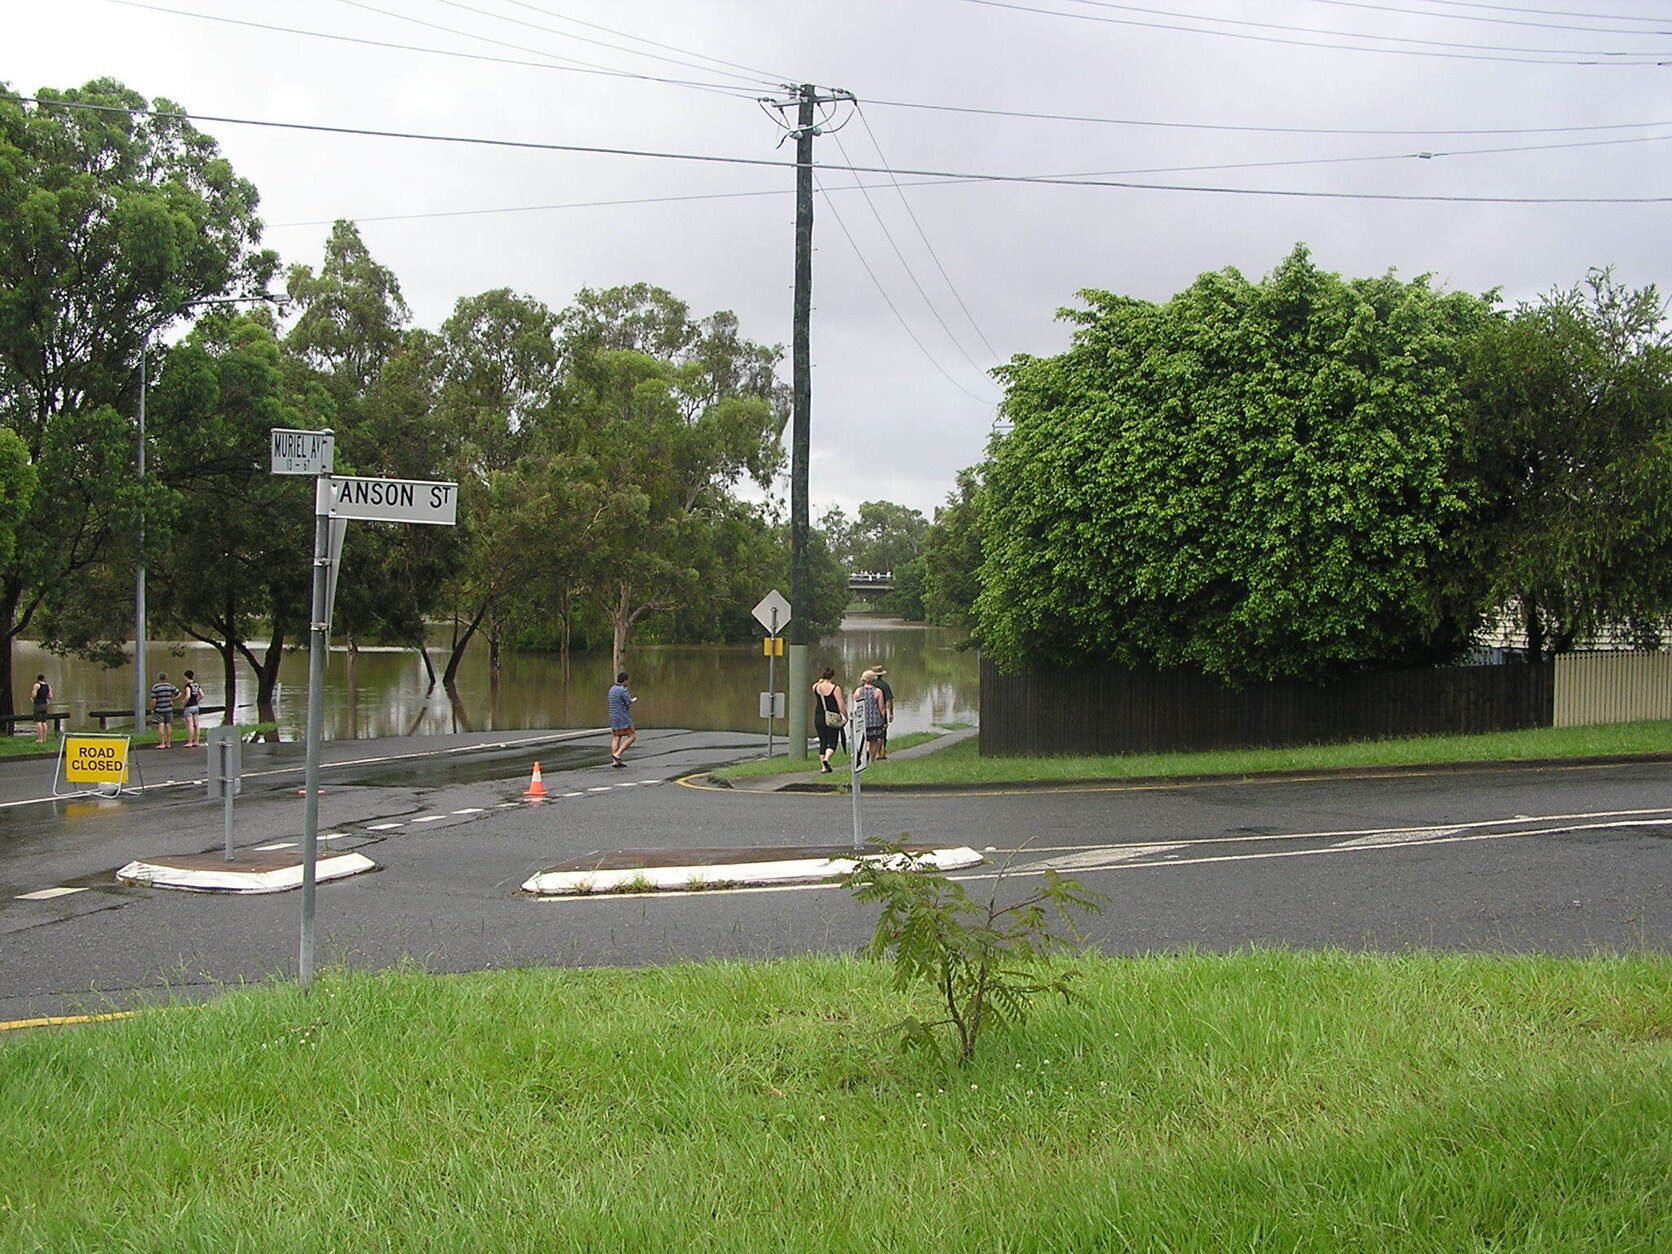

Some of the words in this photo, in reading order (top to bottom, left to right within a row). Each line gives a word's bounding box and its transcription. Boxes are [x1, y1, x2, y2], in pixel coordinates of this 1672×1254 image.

[274, 434, 307, 458] MURIEL
[339, 481, 414, 507] ANSON
[429, 486, 451, 508] ST
[79, 747, 115, 758] ROAD
[71, 760, 123, 771] CLOSED
